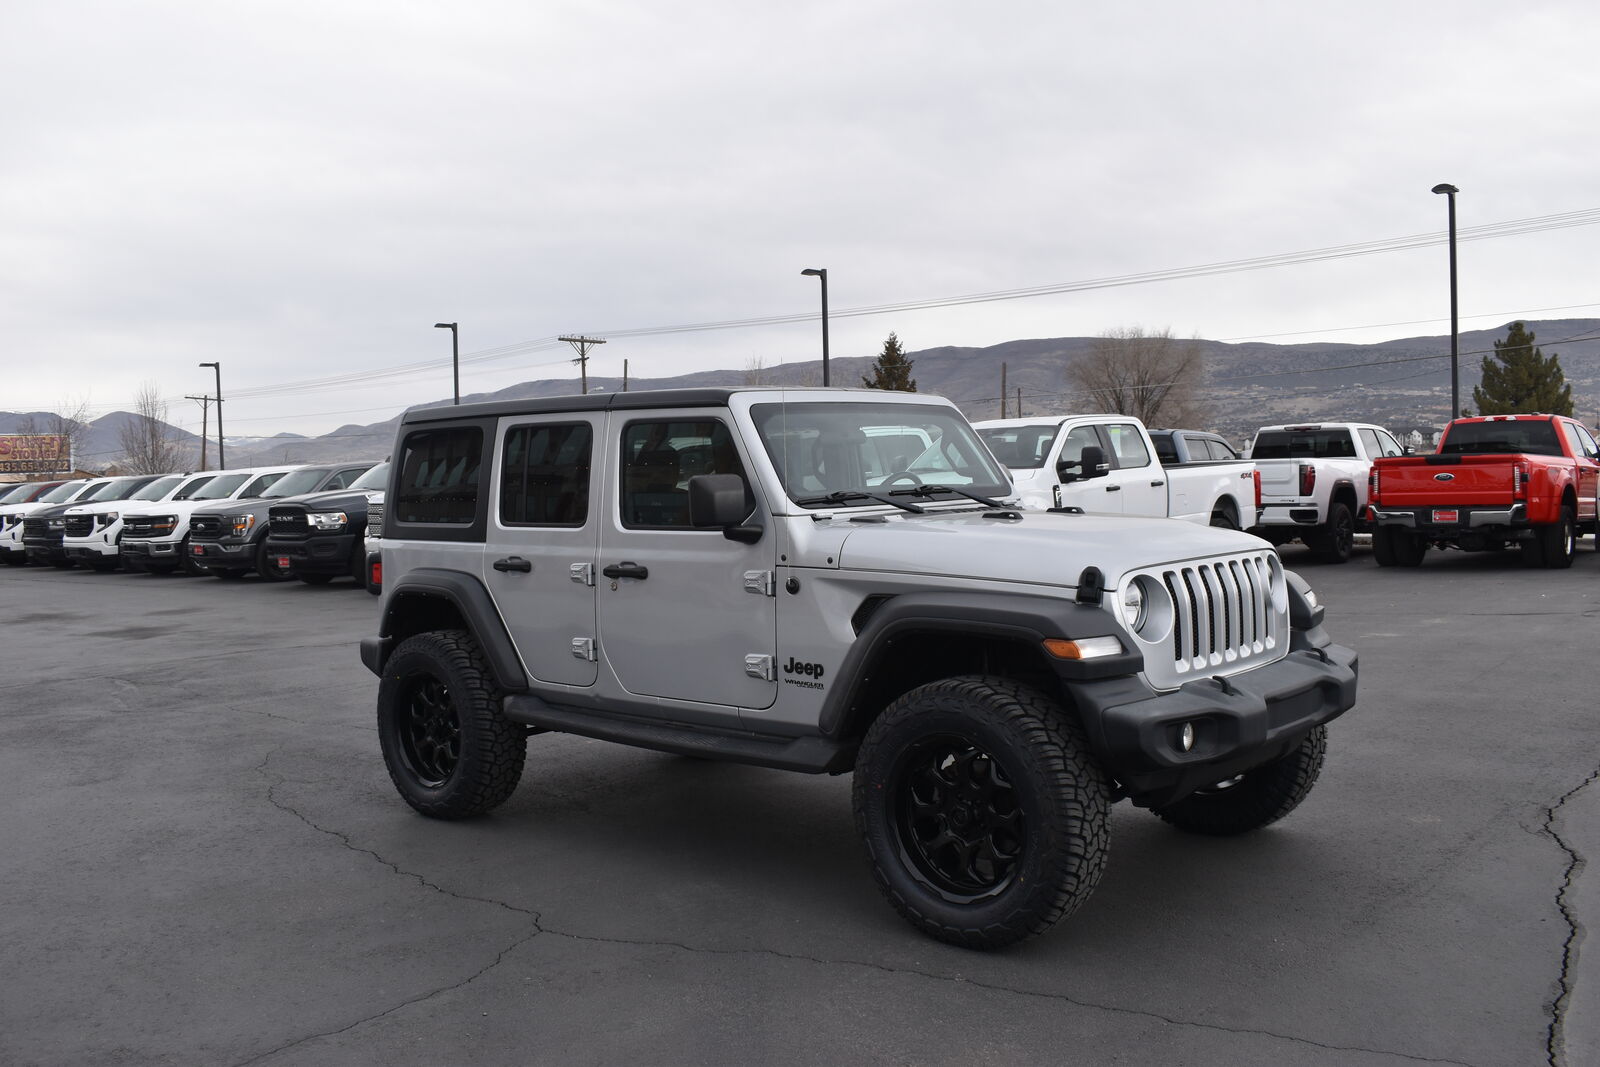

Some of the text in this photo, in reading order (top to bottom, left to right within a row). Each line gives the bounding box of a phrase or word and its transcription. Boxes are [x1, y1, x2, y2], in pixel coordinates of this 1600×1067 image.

[11, 449, 57, 459] STORAGE
[783, 656, 825, 680] Jeep
[784, 678, 824, 689] WRANGLER
